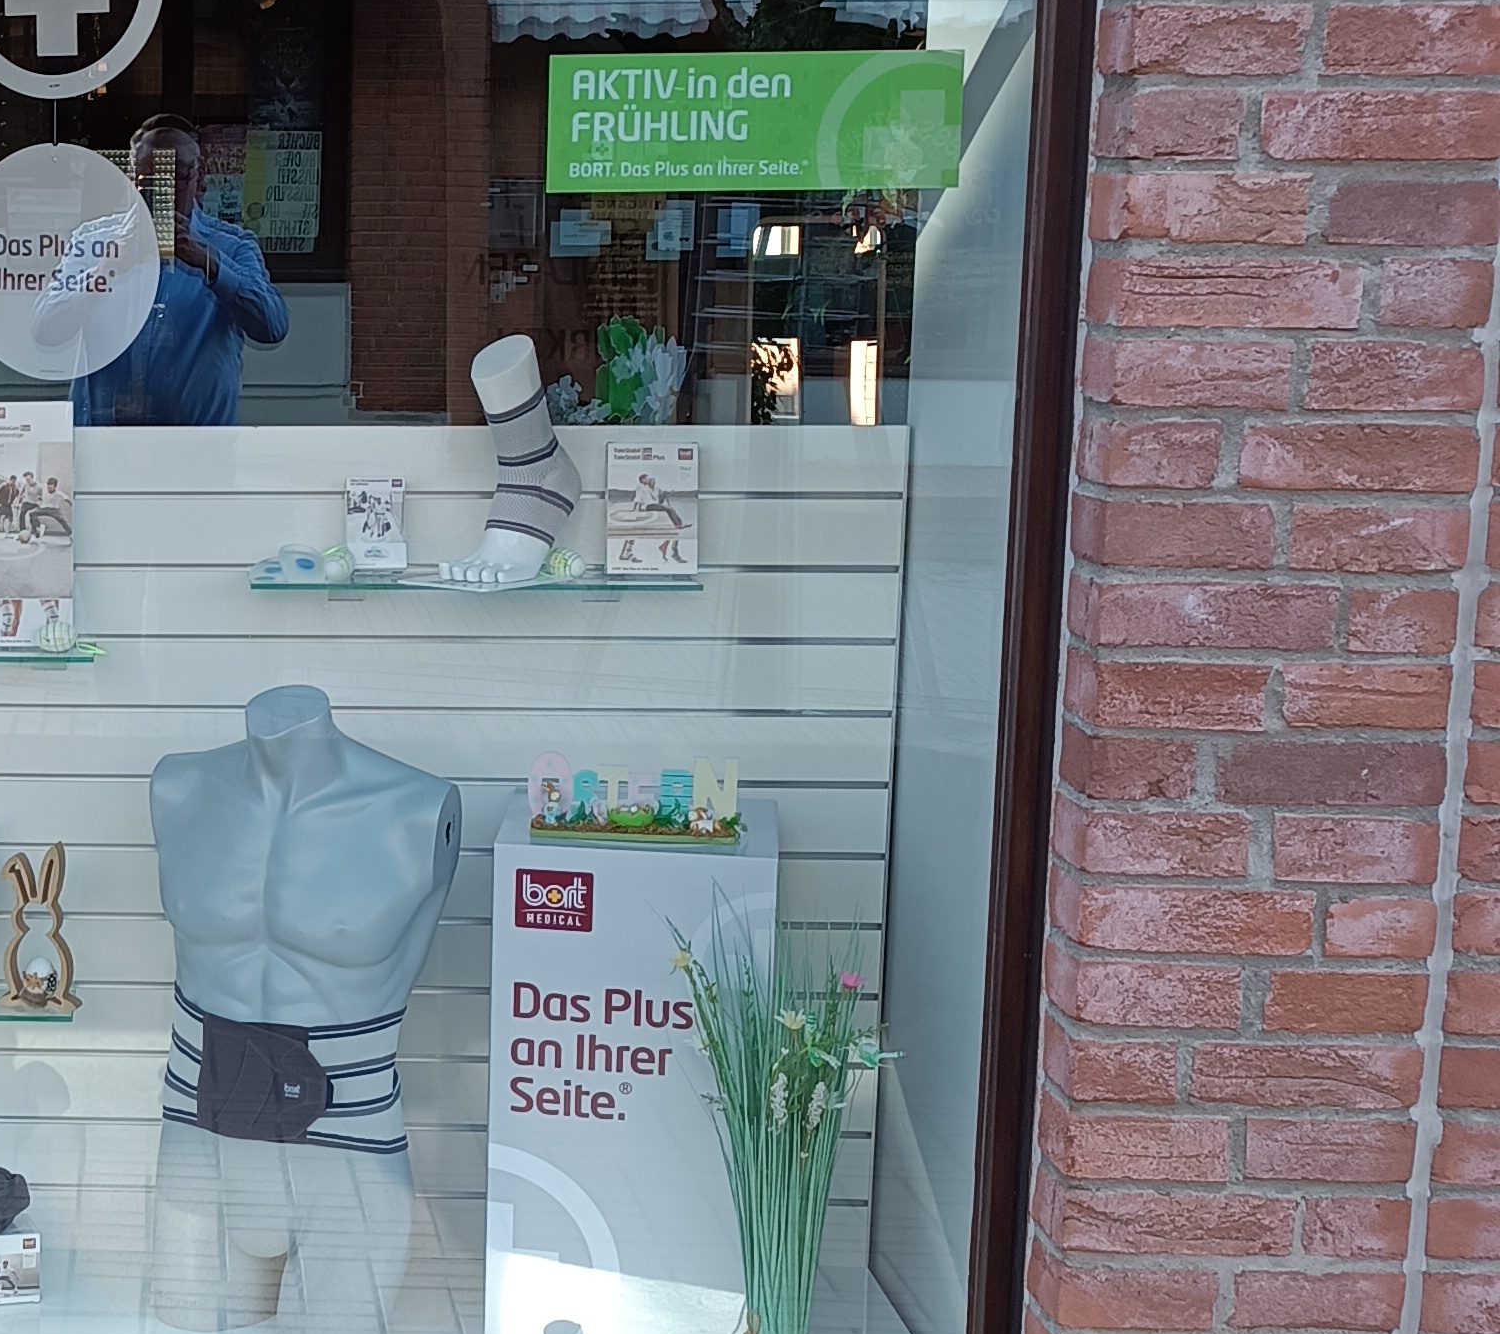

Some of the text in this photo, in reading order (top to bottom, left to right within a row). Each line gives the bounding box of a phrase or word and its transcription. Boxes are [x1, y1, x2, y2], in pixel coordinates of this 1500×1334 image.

[571, 67, 792, 101] AKTIV in den
[571, 104, 749, 143] FRÜHLING
[568, 162, 616, 179] BORT.
[620, 161, 651, 178] Das
[654, 160, 689, 177] Plus
[692, 164, 714, 177] an
[717, 160, 755, 177] Ihrer
[38, 233, 85, 258] Plus
[91, 239, 119, 259] an
[527, 750, 739, 823] OSTERN
[521, 873, 588, 910] bort
[525, 912, 582, 927] MEDICAL
[512, 981, 694, 1030] Das Plus
[510, 1034, 673, 1076] an Ihrer
